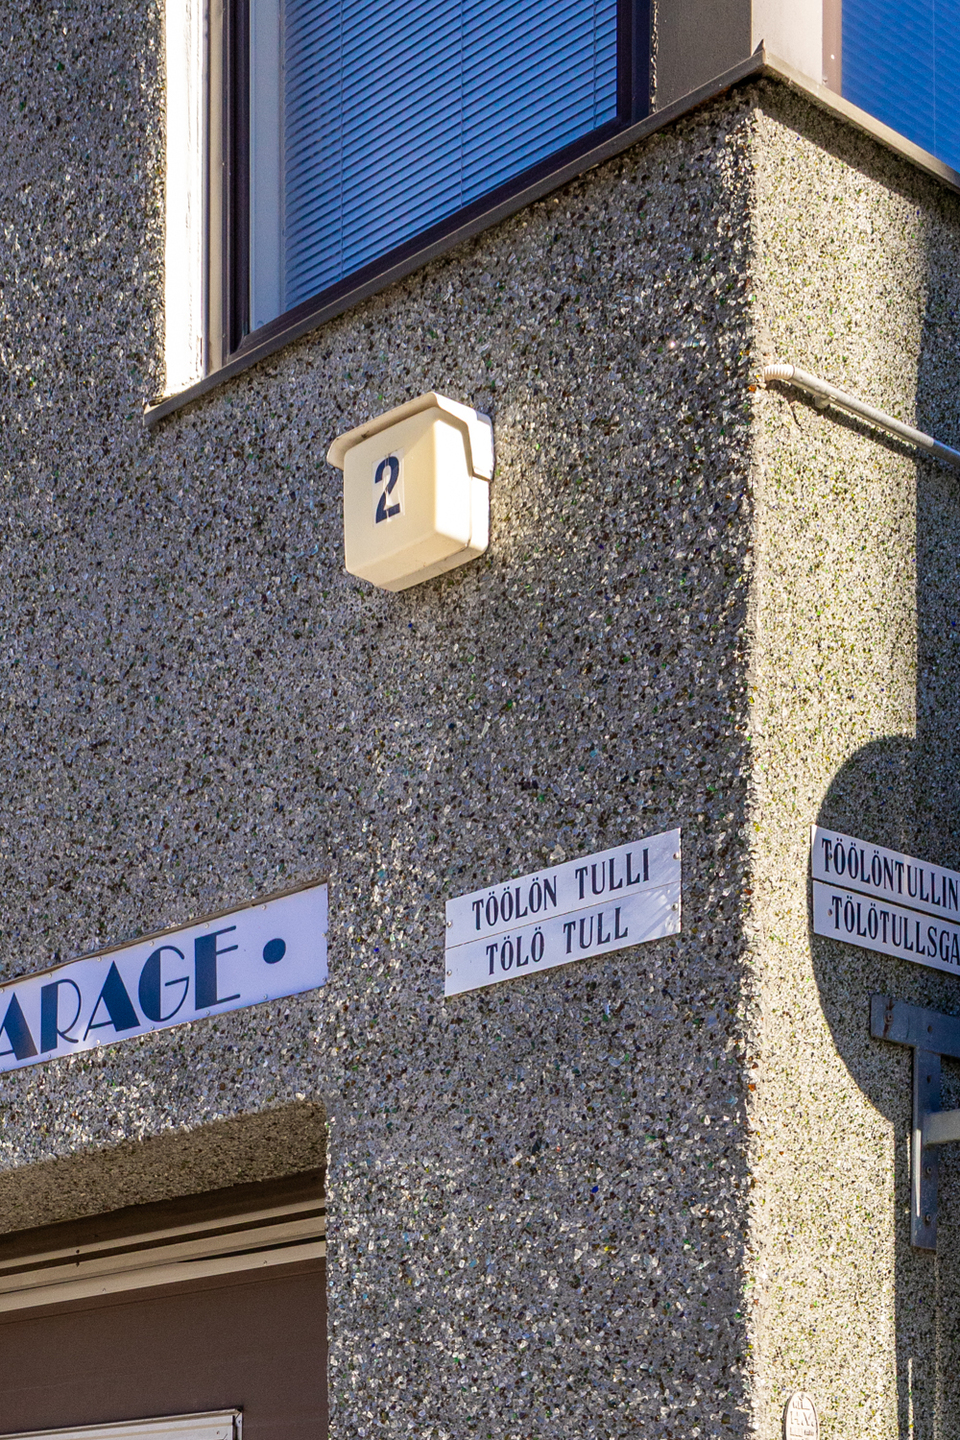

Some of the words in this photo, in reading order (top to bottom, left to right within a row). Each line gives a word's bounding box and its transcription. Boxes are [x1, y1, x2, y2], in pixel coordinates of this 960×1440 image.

[374, 456, 401, 524] 2
[472, 875, 557, 930] TÖÖLÖN
[575, 848, 650, 900] TULLI
[485, 926, 545, 976] TÖLÖ
[563, 906, 628, 955] TULL
